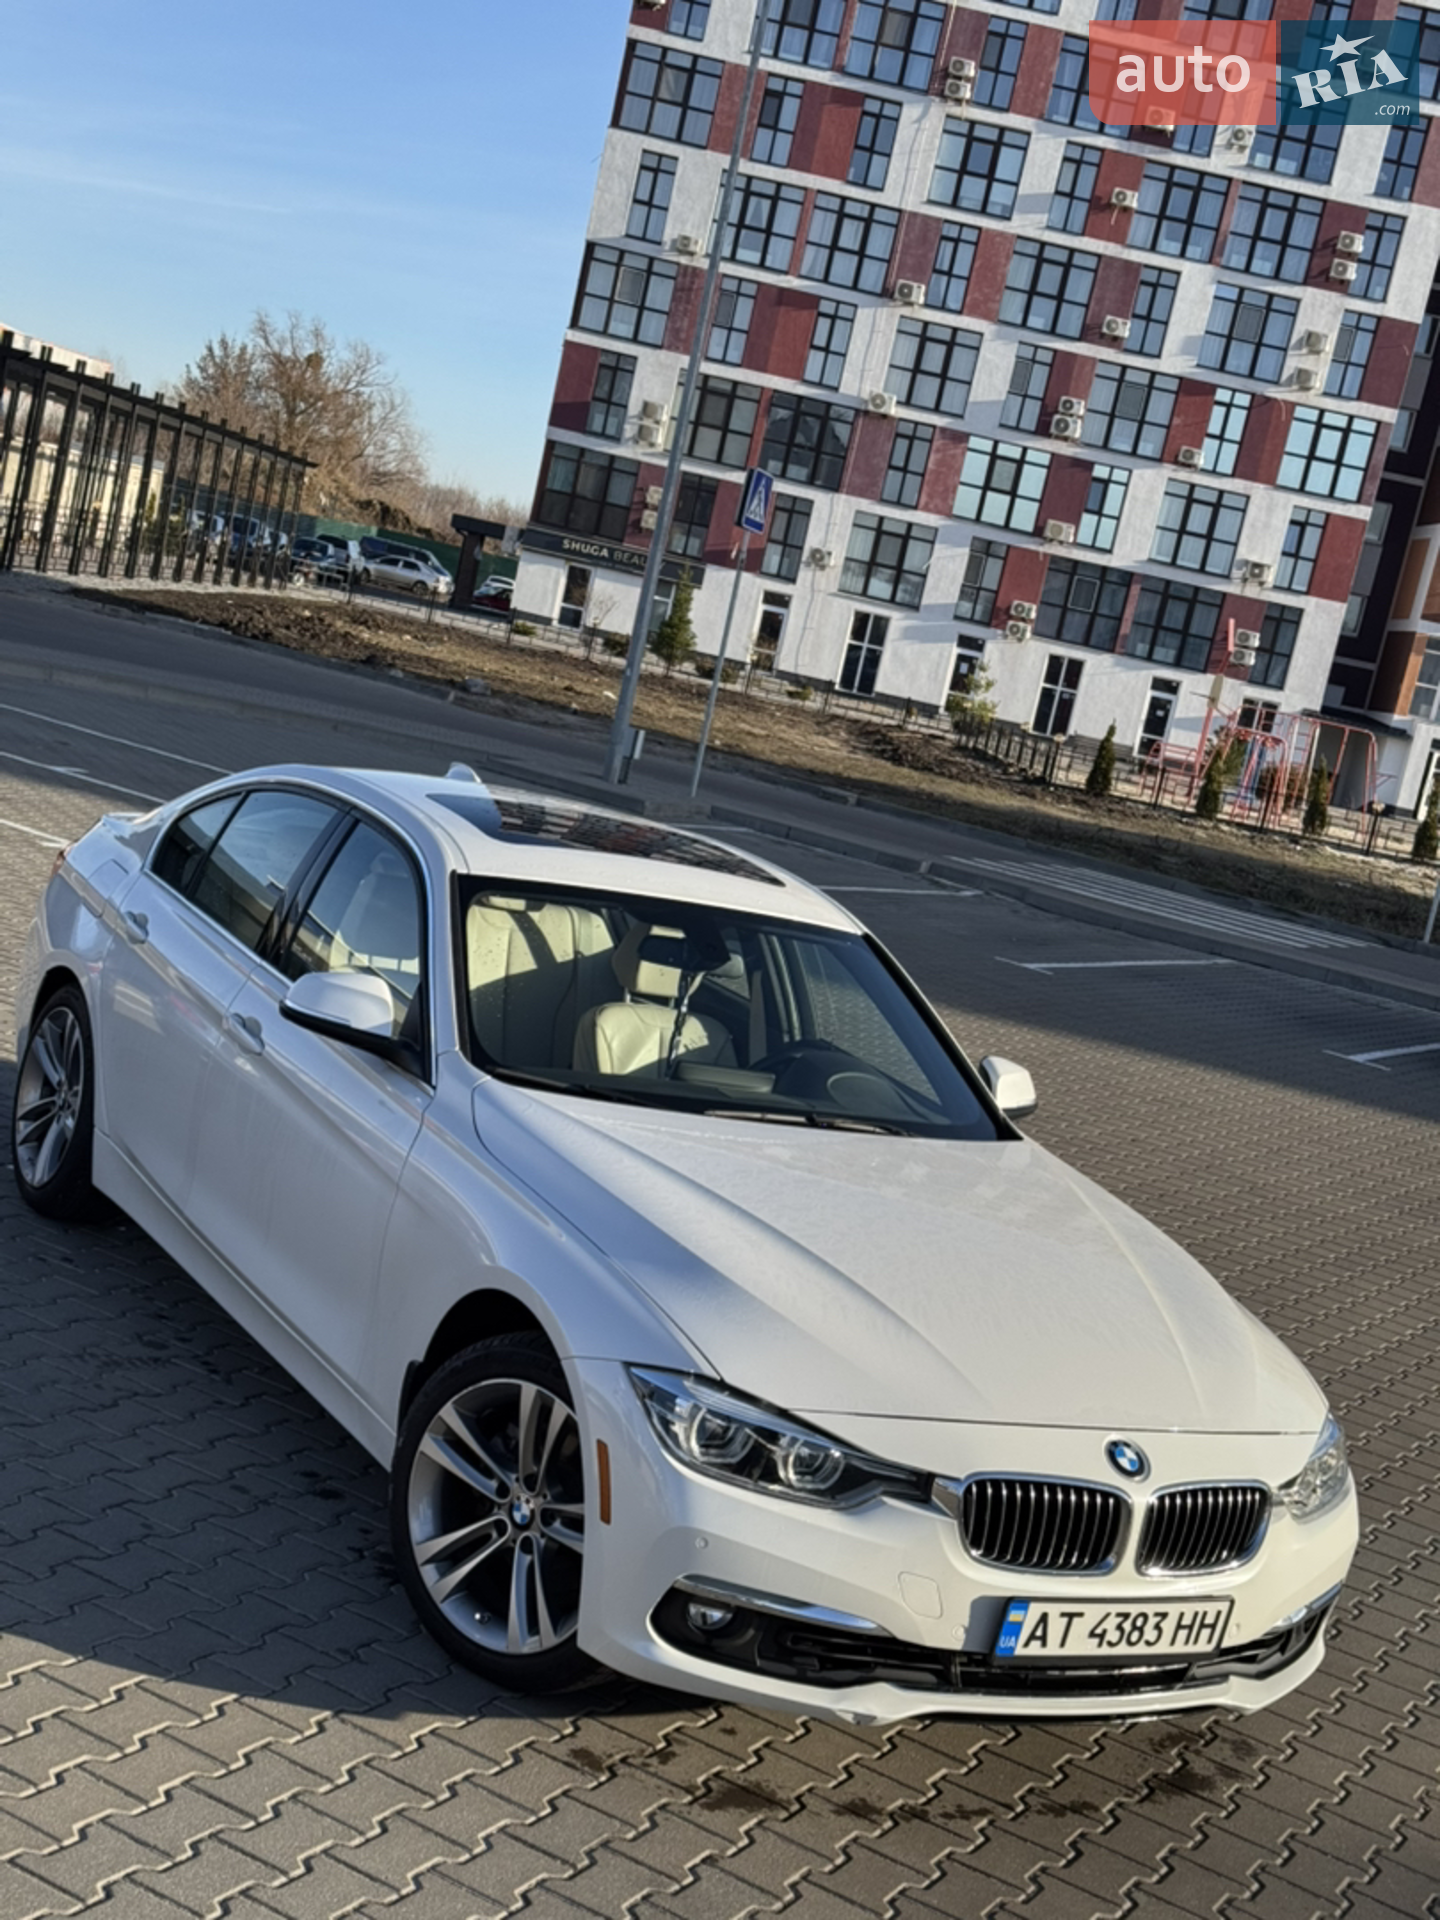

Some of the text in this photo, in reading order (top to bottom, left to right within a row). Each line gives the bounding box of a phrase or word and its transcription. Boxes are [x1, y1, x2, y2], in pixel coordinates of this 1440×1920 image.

[999, 1635, 1016, 1649] UA
[1022, 1610, 1222, 1648] AT 4383 HH
